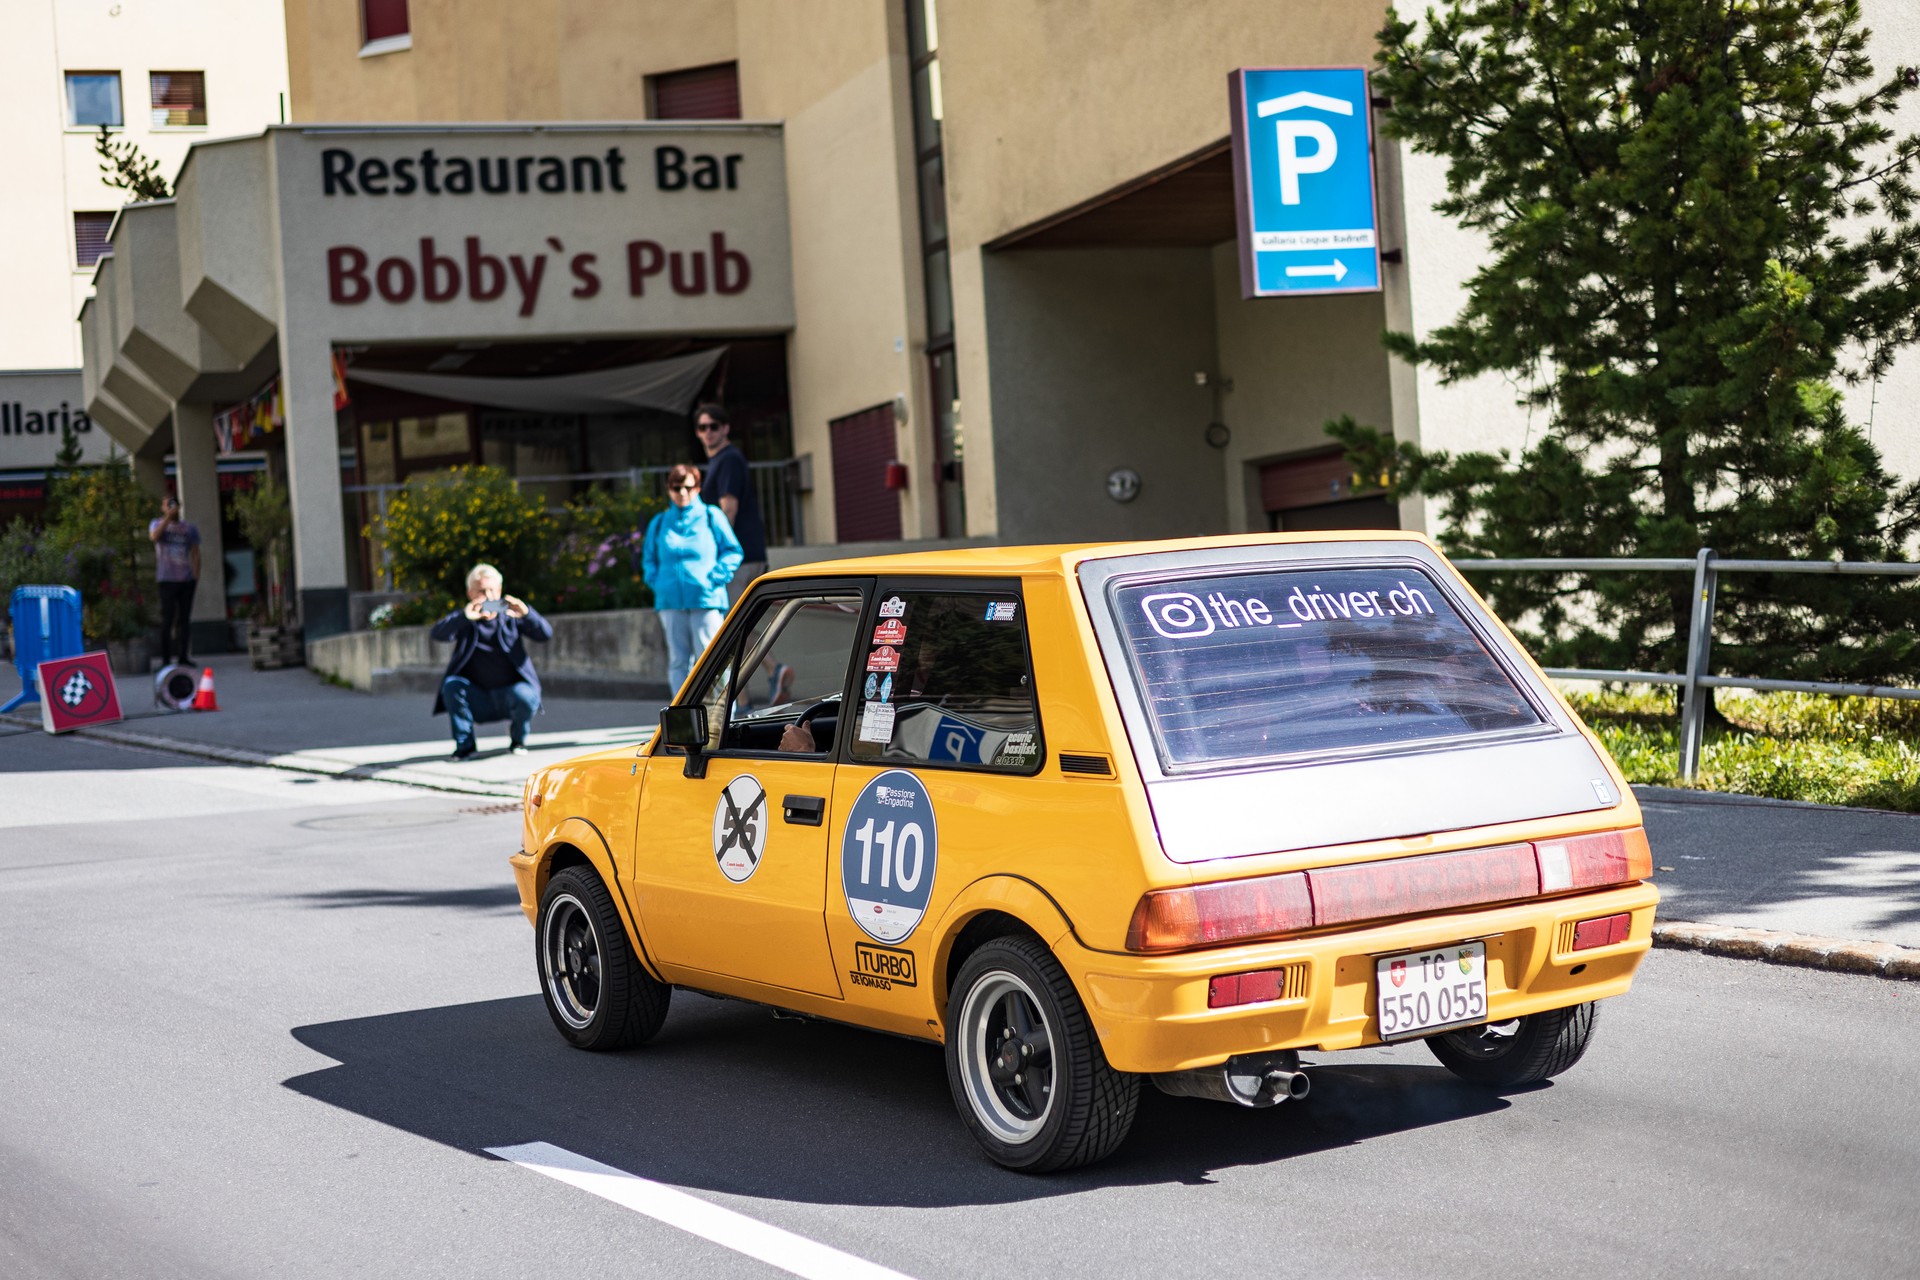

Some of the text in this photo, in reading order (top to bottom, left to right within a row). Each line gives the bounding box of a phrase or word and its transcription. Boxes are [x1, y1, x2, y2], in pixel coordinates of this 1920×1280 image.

[322, 145, 743, 196] Restaurant Bar
[1276, 119, 1338, 205] P
[627, 231, 753, 297] Pub
[1208, 581, 1435, 628] the_driver.ch
[884, 796, 914, 809] Engadina
[886, 786, 915, 799] Passione
[855, 818, 924, 892] 110
[860, 950, 911, 979] TURBO
[1420, 953, 1445, 983] TG
[1383, 980, 1483, 1031] 550 055
